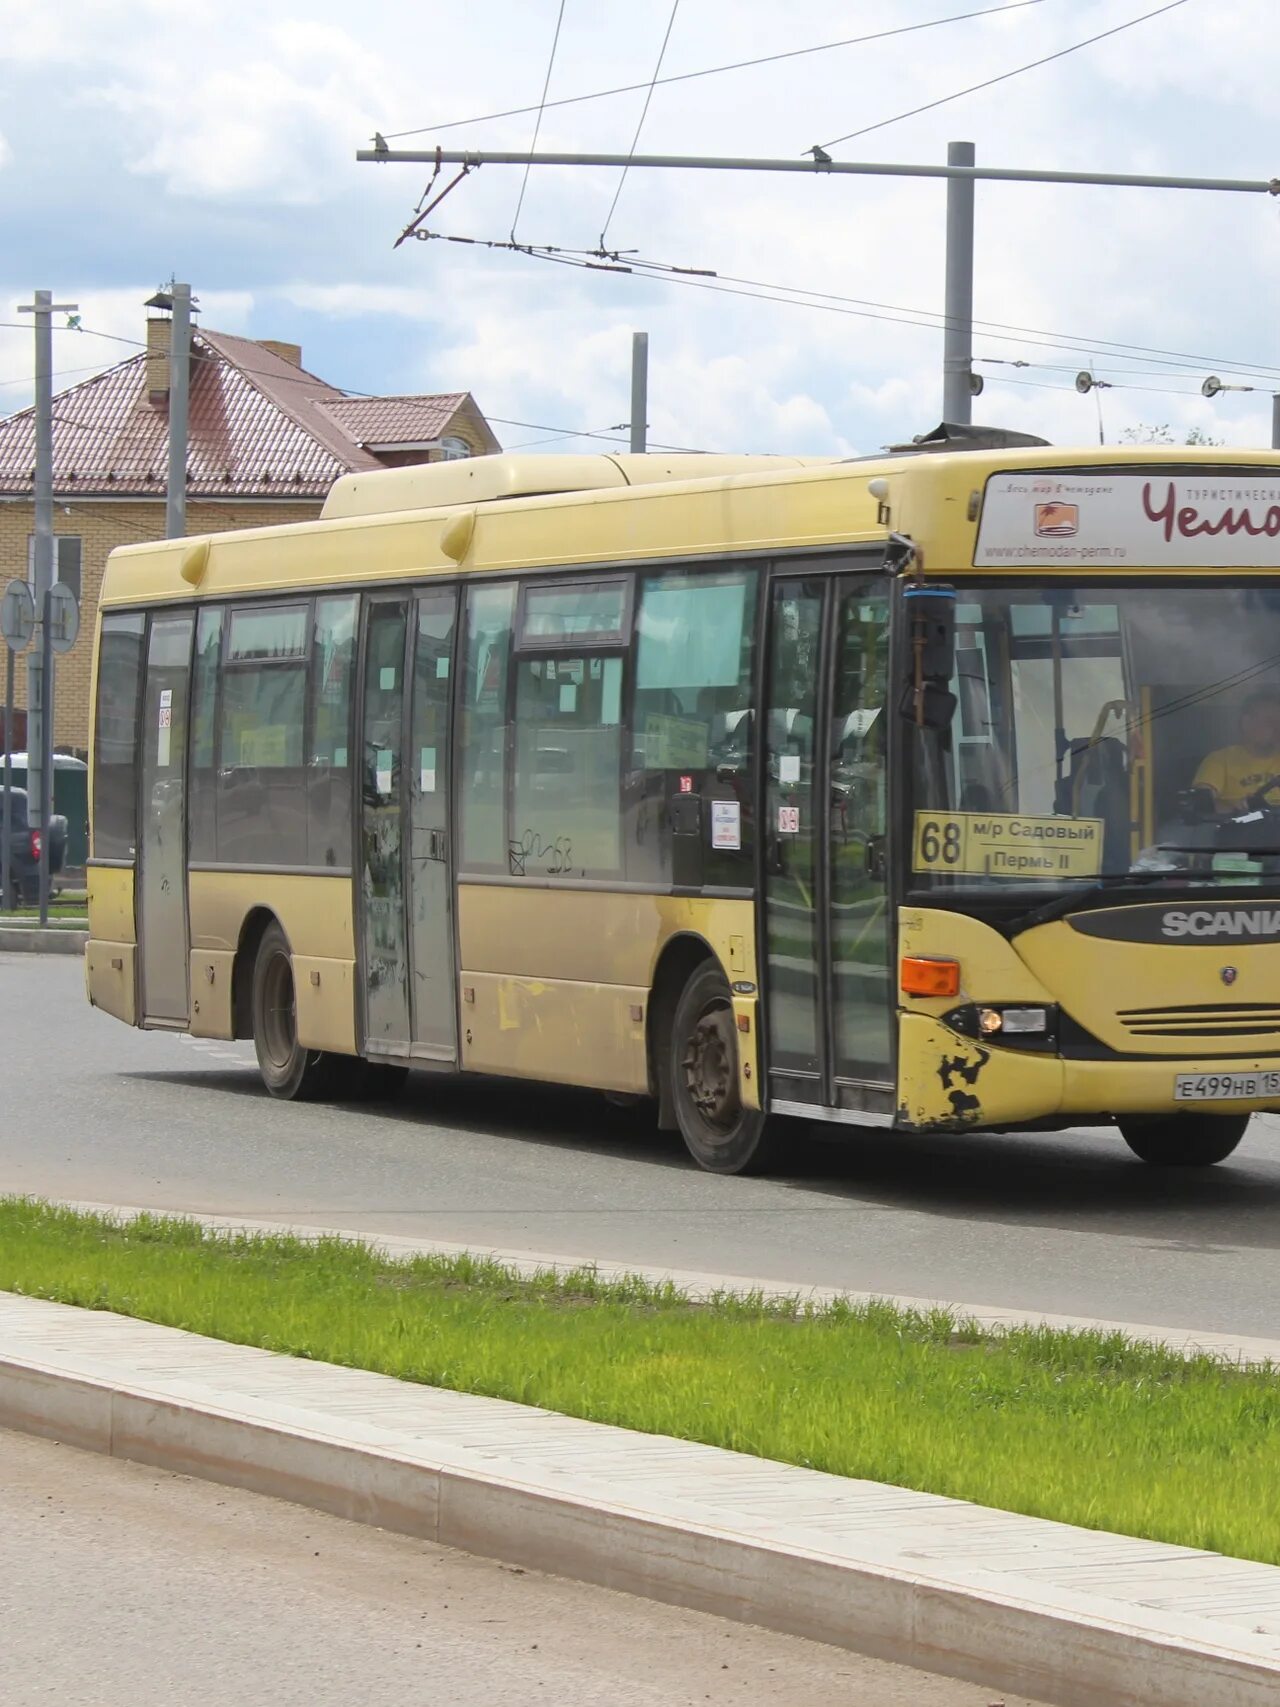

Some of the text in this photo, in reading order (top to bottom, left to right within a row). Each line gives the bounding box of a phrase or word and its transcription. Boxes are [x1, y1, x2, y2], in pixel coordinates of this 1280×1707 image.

[983, 545, 1127, 560] www.chemodan-perm.ru
[973, 821, 1094, 840] м/р Садовый
[921, 821, 960, 864] 68
[994, 851, 1054, 870] Пермь
